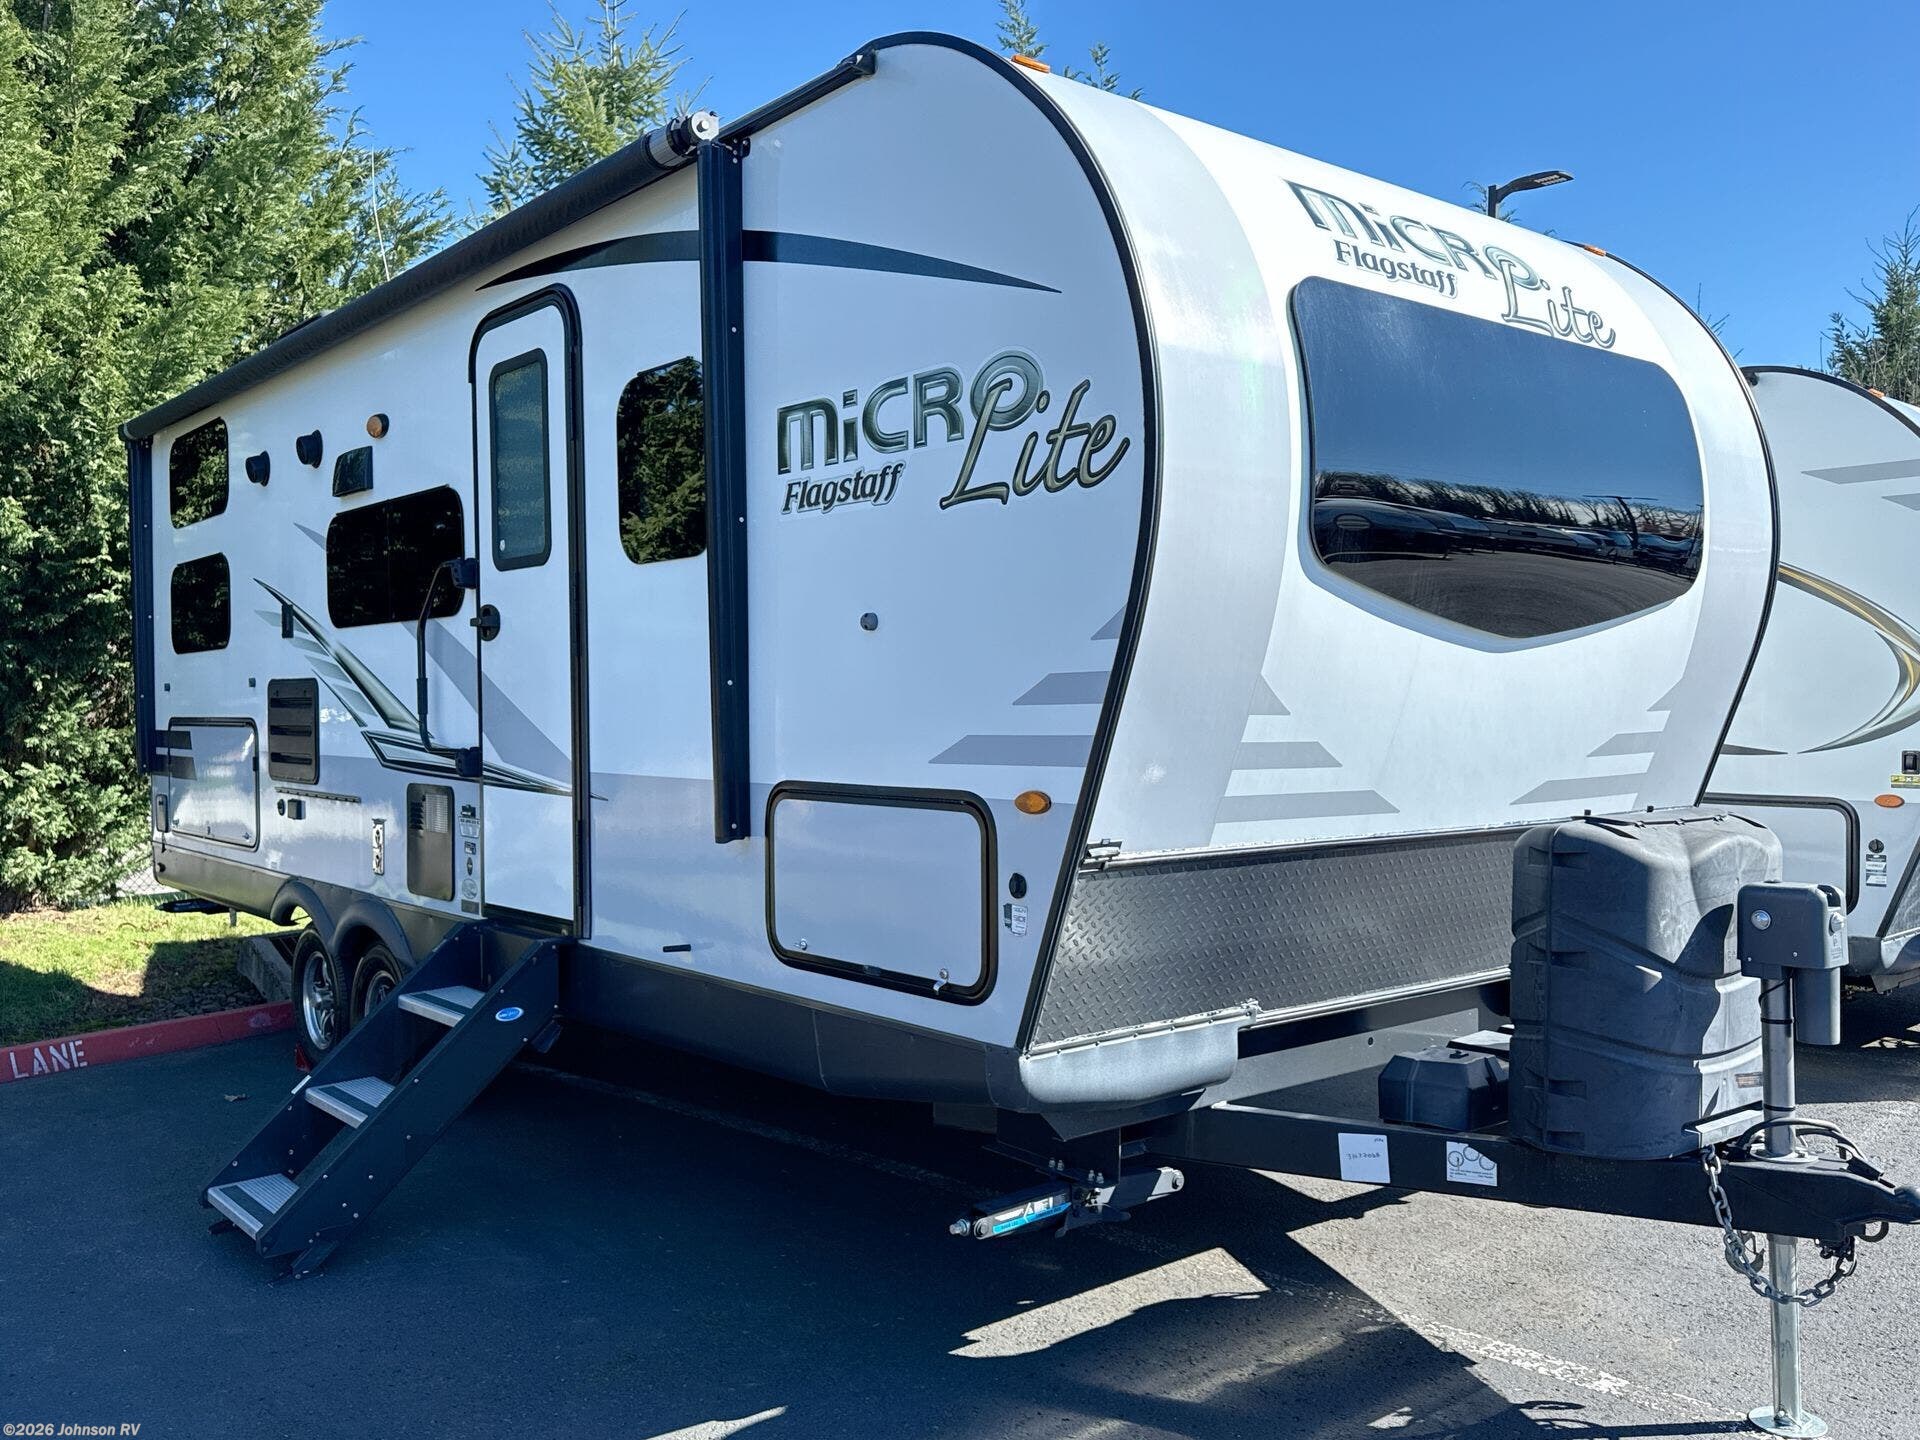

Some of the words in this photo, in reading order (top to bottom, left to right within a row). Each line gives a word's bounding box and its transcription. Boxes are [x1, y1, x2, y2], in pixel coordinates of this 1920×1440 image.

[1333, 239, 1457, 296] Flagstaff
[1501, 259, 1616, 349] Lite
[940, 378, 1130, 510] Lite
[782, 463, 903, 512] Flagstaff
[9, 1040, 88, 1079] LANE
